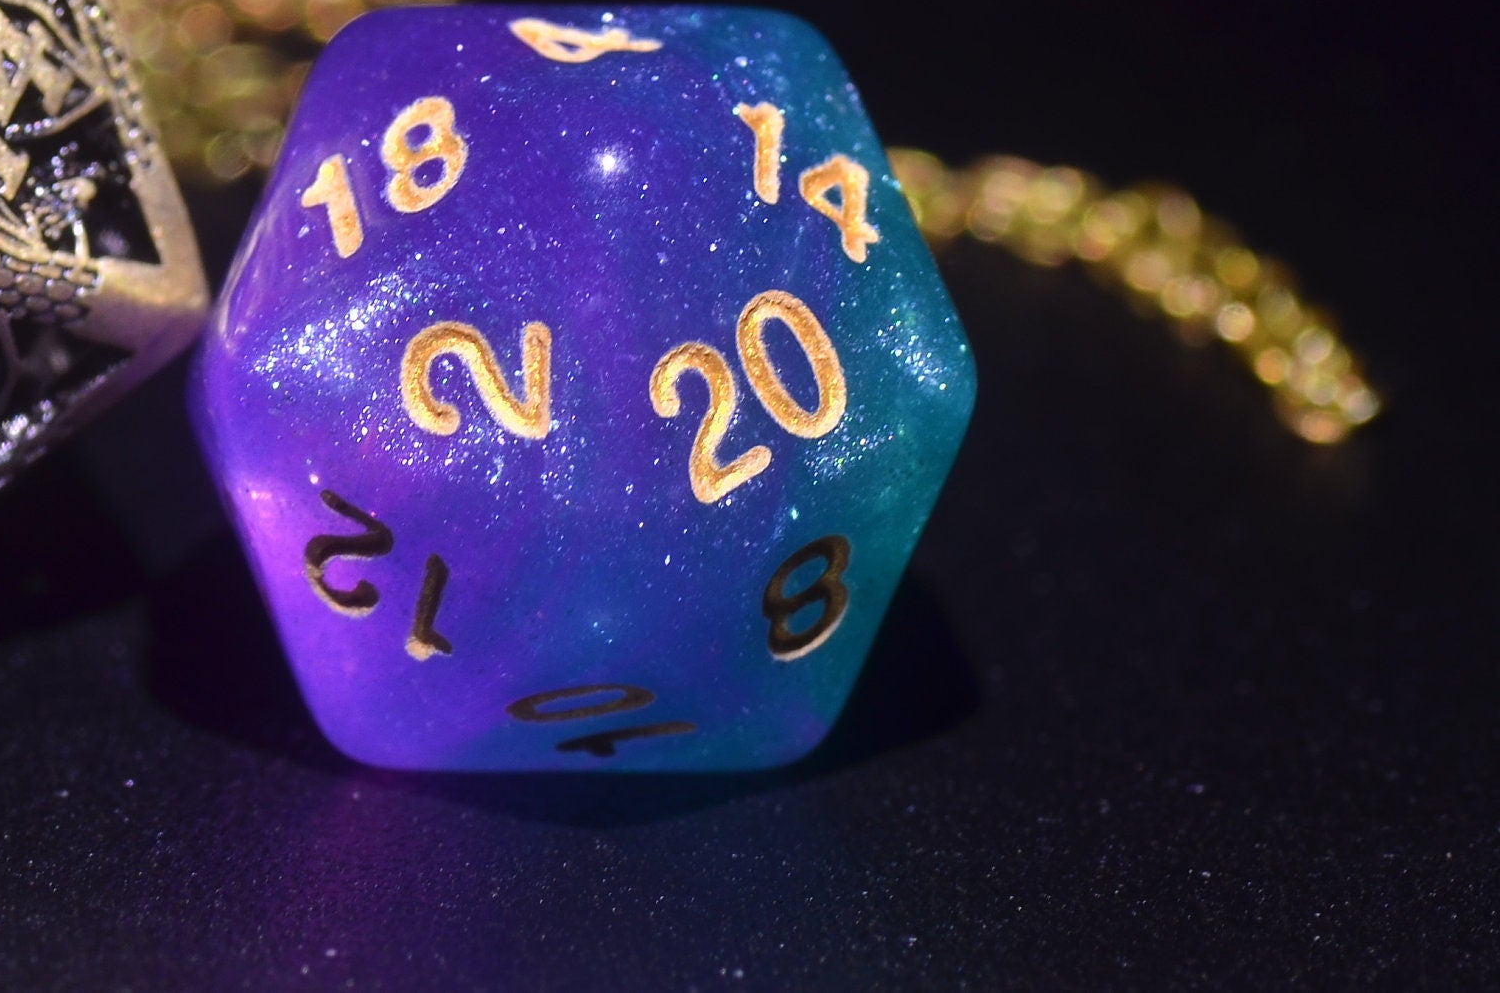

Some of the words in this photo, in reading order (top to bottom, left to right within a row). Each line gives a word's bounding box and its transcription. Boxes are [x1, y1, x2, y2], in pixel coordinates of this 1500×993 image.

[301, 95, 468, 258] 18
[737, 101, 881, 263] 14
[400, 321, 553, 441] 2
[648, 289, 847, 503] 20
[303, 489, 454, 662] 12
[761, 534, 853, 663] 8
